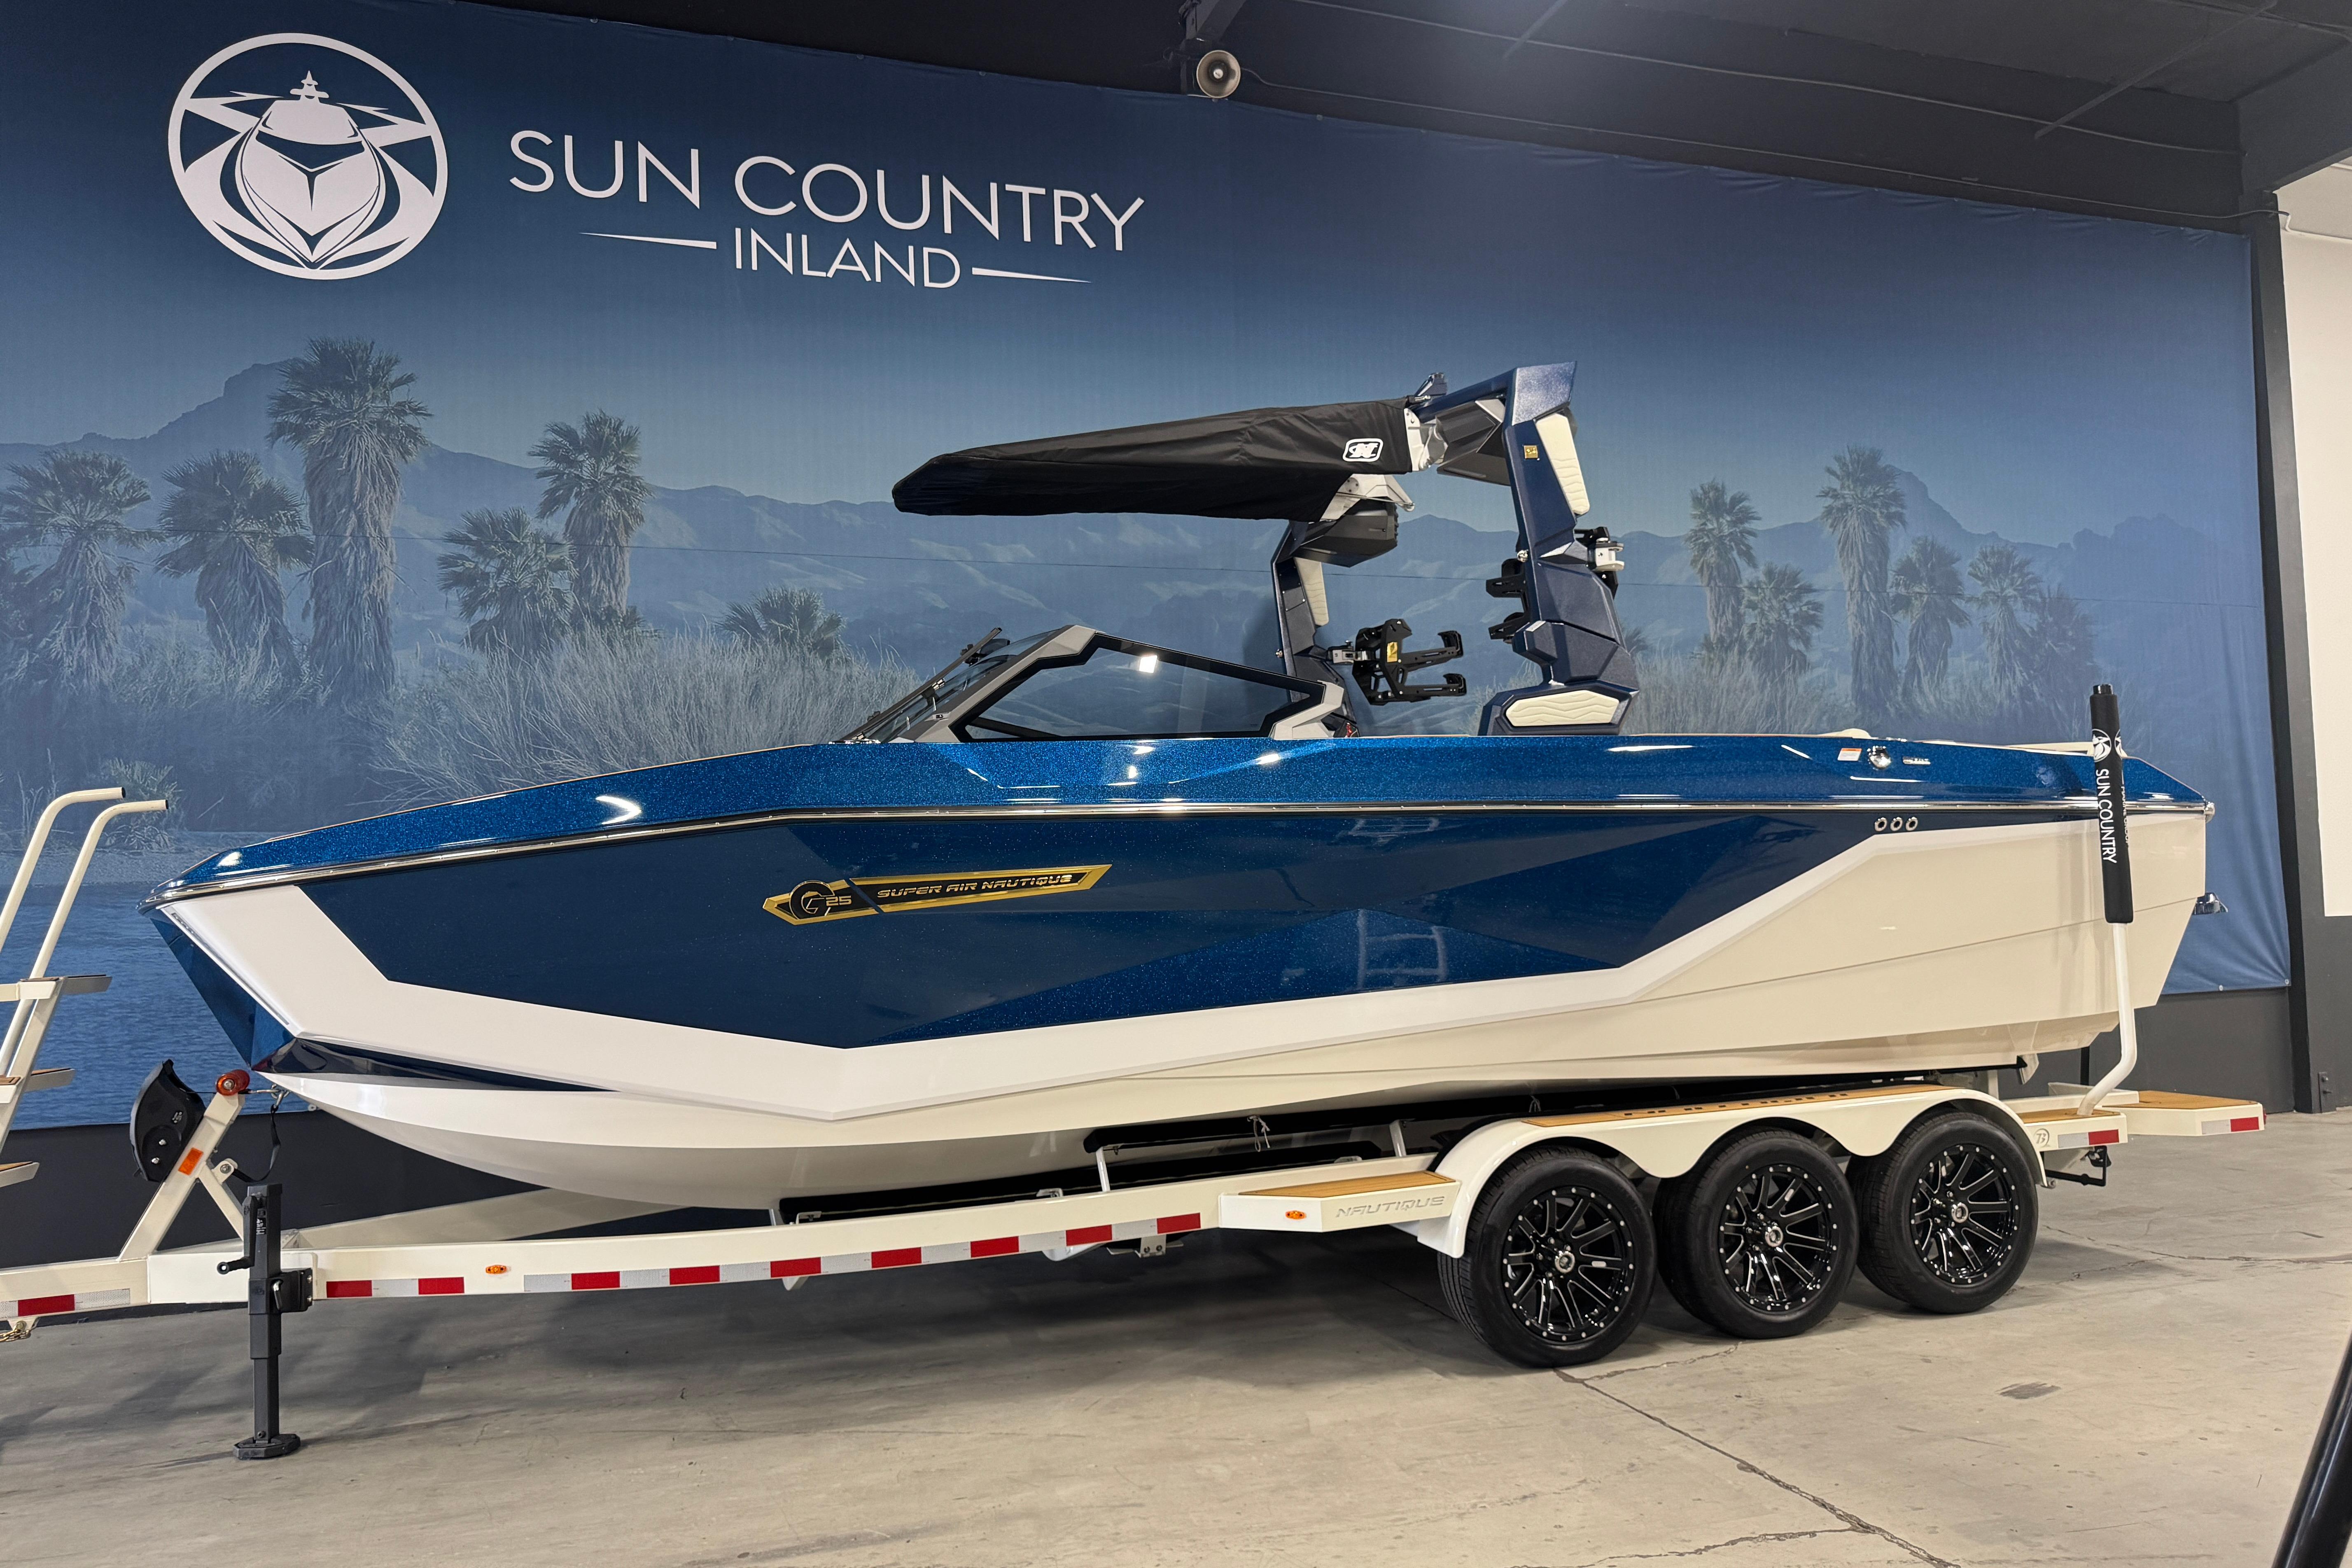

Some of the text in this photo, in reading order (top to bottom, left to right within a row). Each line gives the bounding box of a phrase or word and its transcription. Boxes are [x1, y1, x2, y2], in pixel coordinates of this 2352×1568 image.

[509, 130, 1145, 251] SUN COUNTRY
[734, 227, 961, 289] INLAND
[2095, 768, 2117, 863] SUN COUNTRY
[877, 885, 942, 898] SUPER
[946, 881, 978, 892] AIR
[981, 874, 1073, 890] NAUTIQUE
[1337, 1196, 1444, 1218] NAUTIQUE
